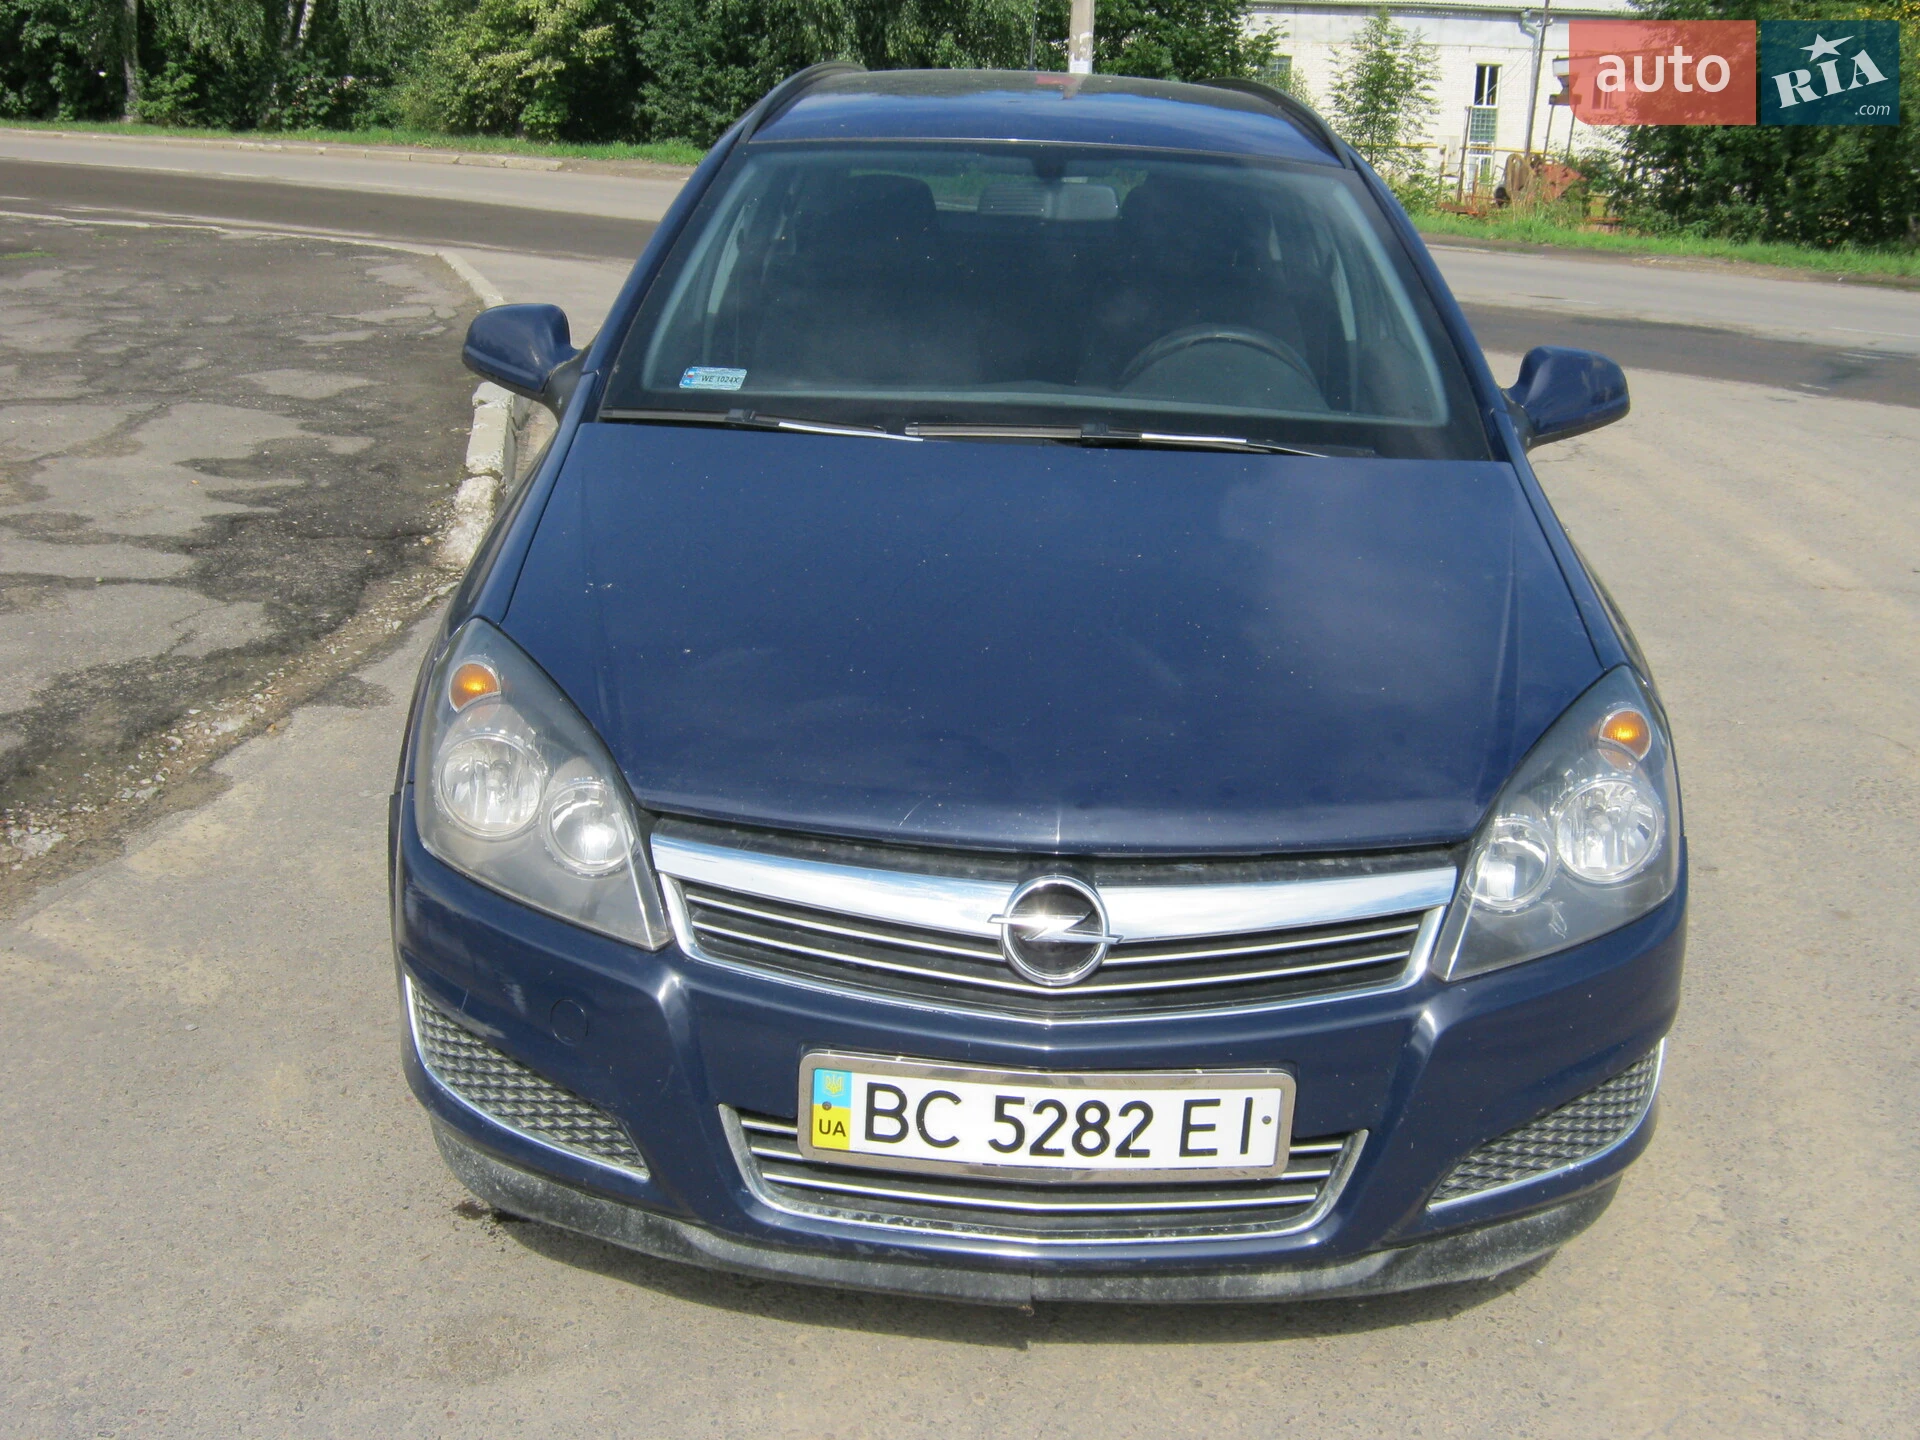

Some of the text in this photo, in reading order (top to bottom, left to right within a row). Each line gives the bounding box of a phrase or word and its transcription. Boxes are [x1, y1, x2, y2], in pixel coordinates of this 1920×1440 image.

[818, 1118, 847, 1139] UA
[864, 1082, 1253, 1158] BC 5282 EI
